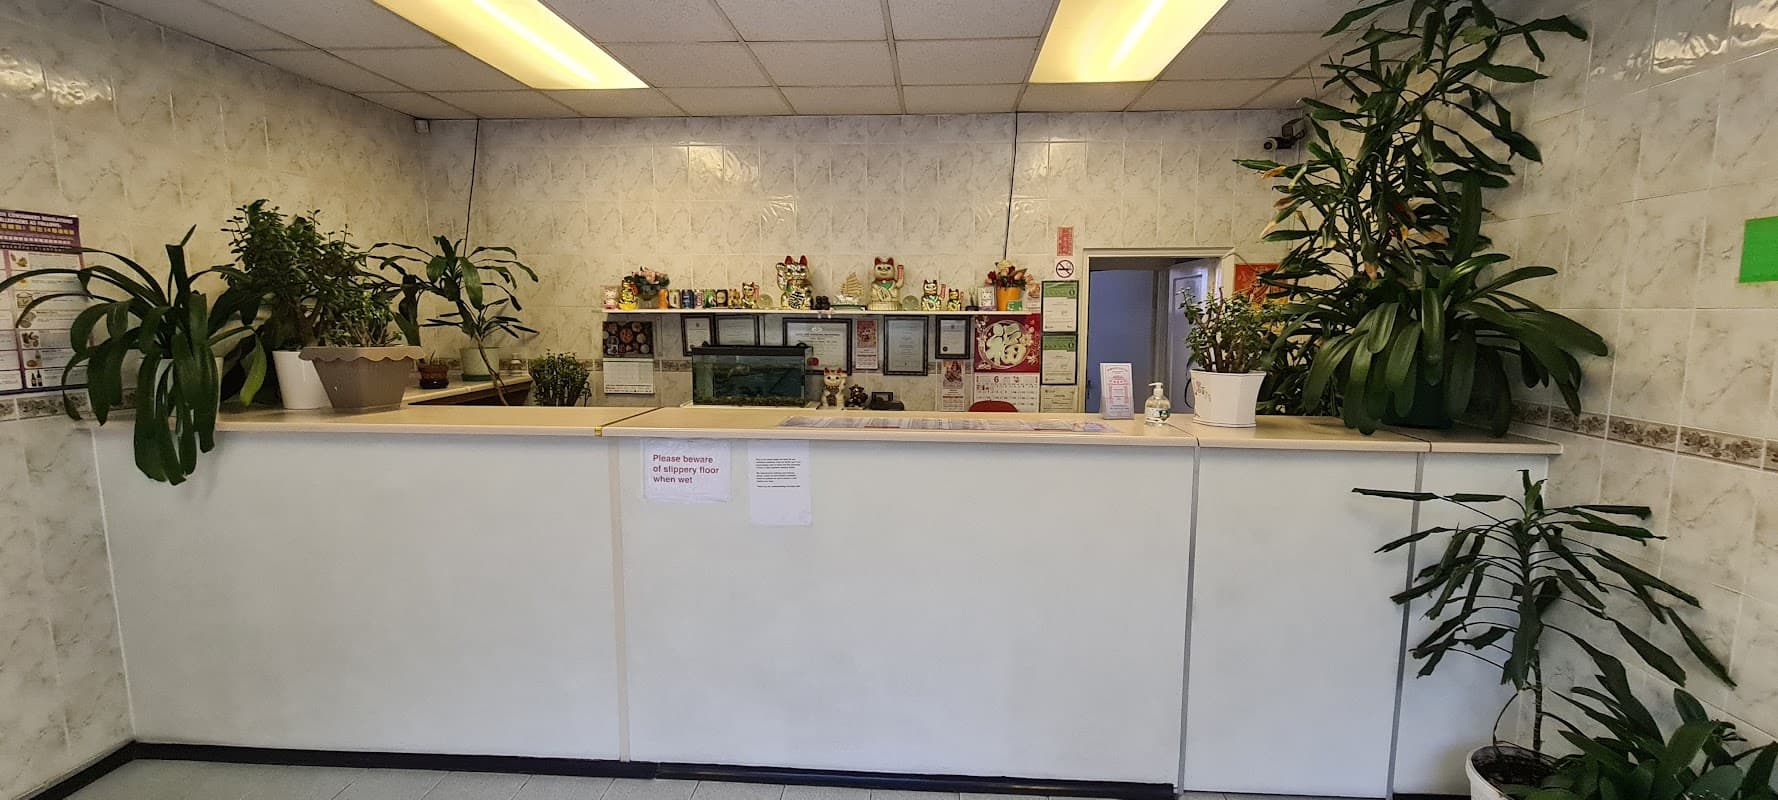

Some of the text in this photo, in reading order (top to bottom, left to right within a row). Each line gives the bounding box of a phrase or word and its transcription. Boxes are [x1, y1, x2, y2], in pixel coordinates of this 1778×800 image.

[652, 454, 714, 464] Please beware
[652, 465, 720, 475] of slippery floor
[653, 475, 693, 484] when wet
